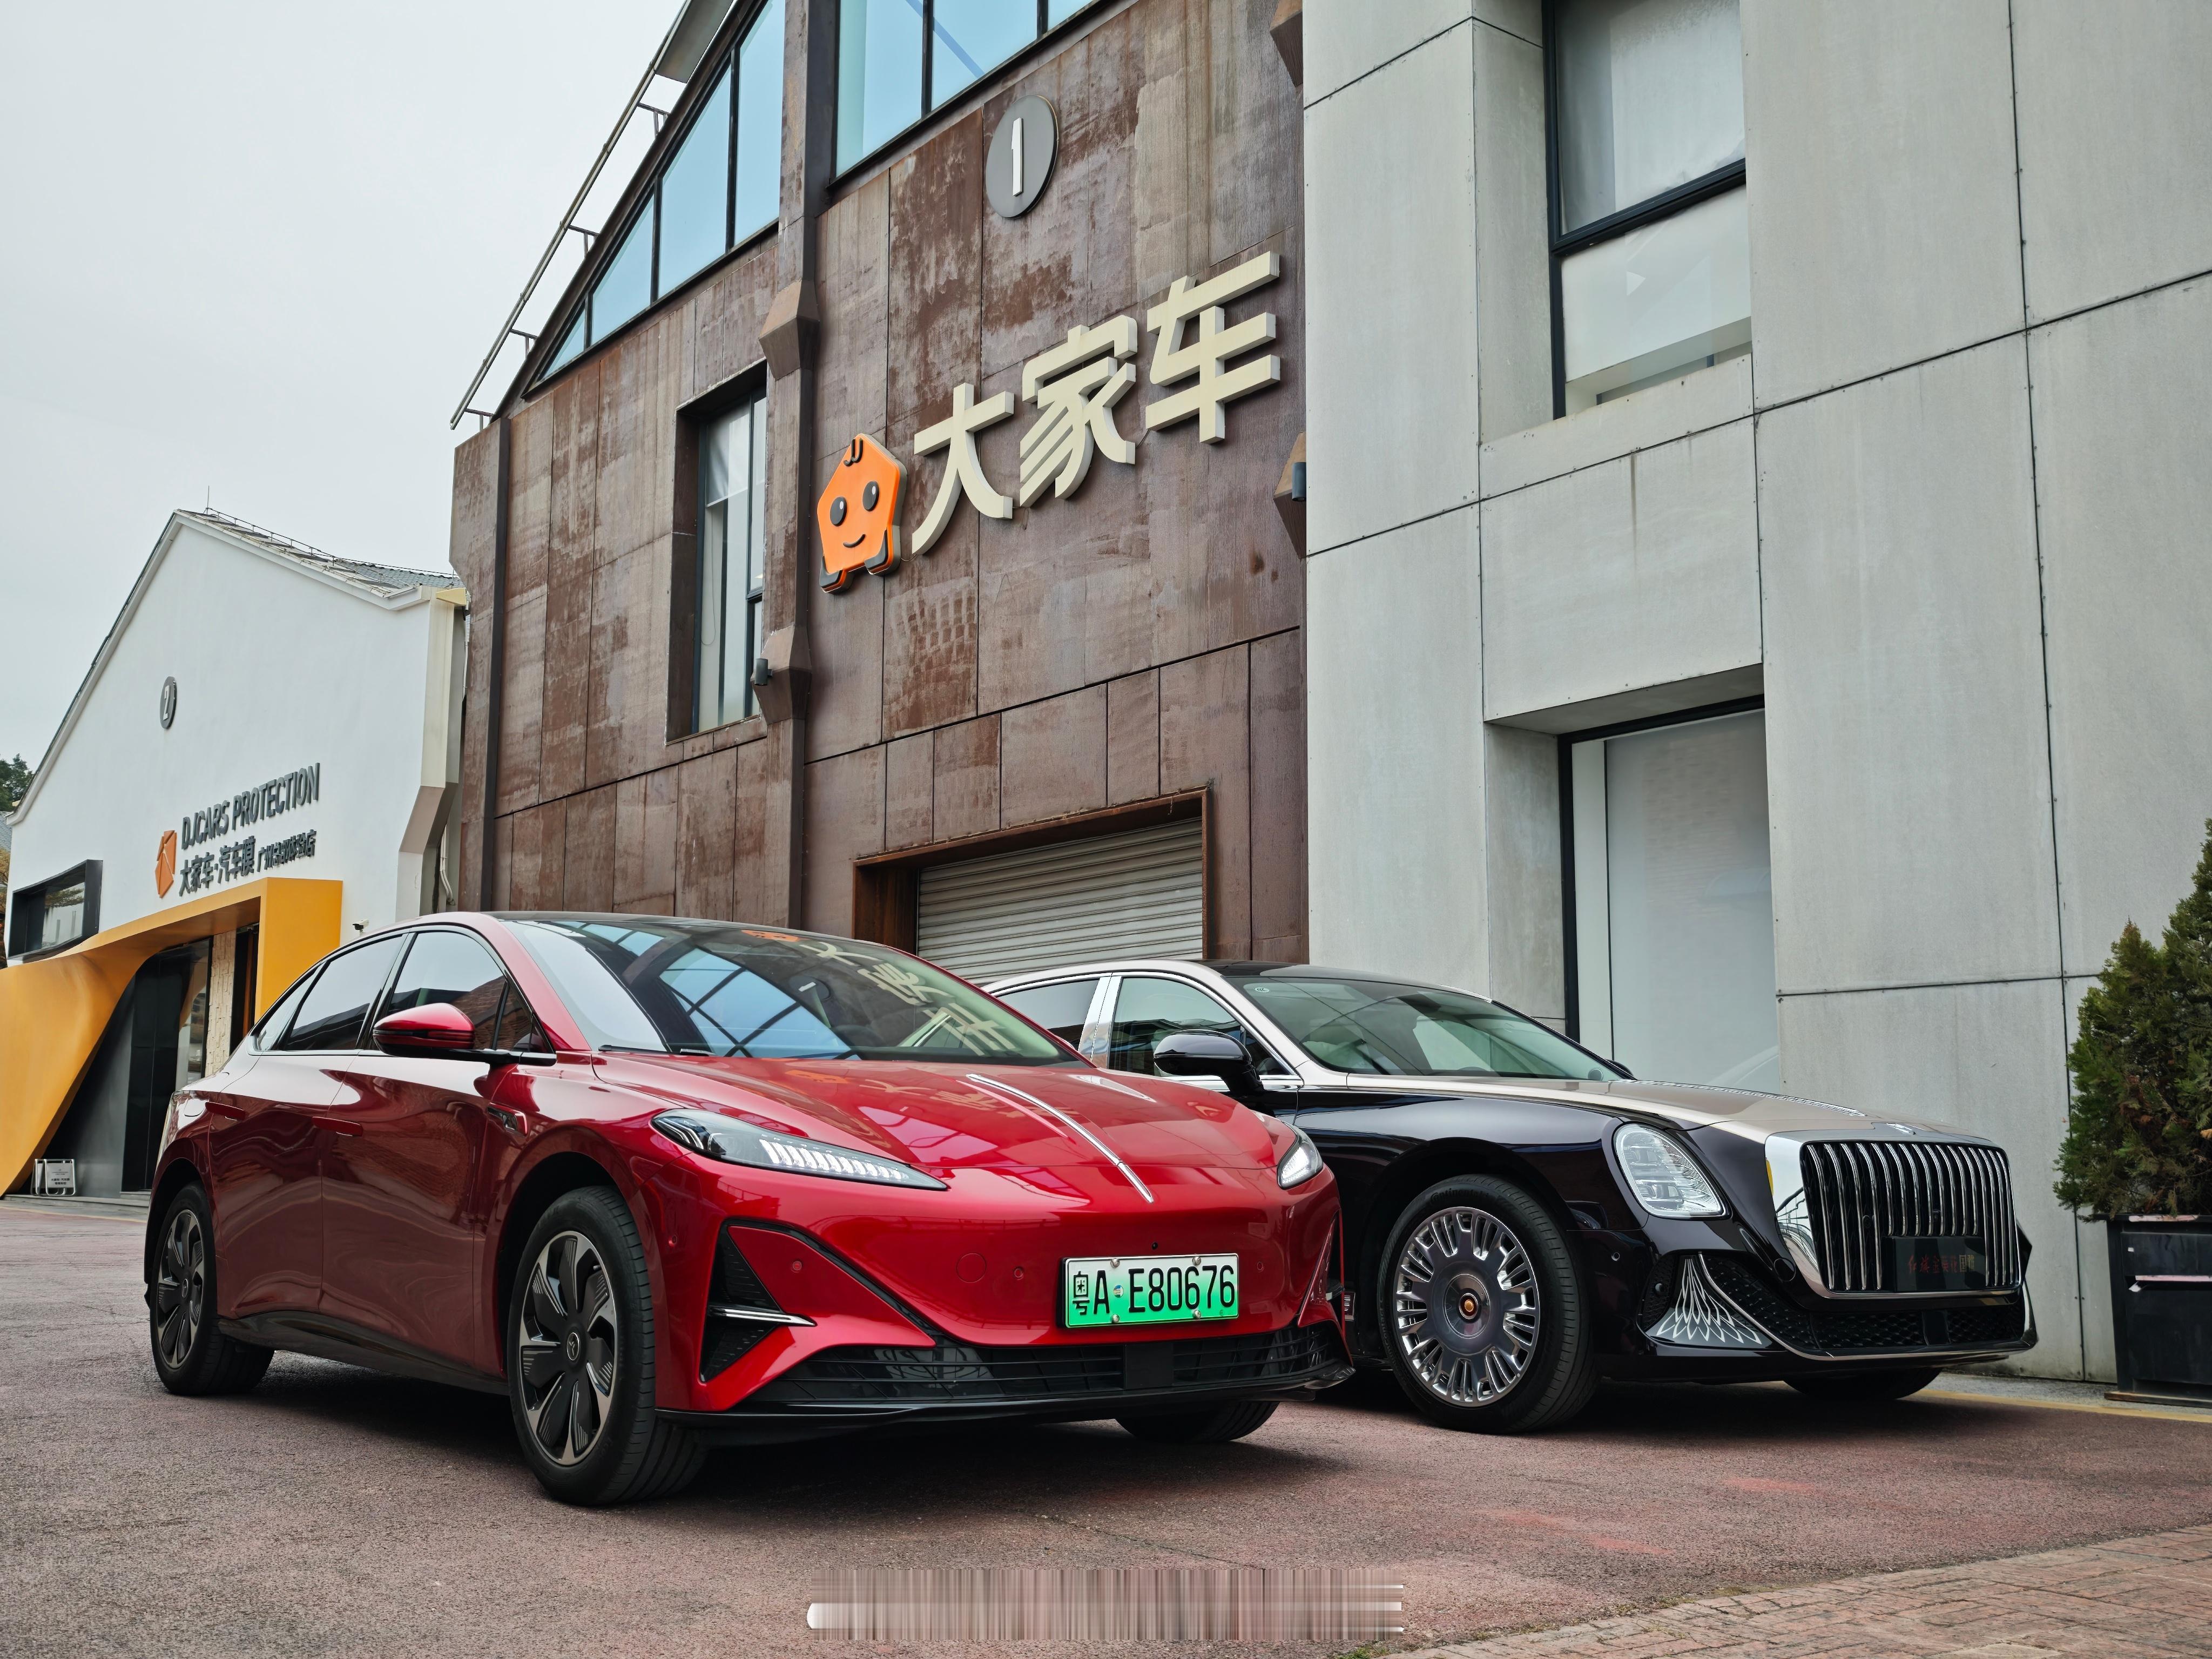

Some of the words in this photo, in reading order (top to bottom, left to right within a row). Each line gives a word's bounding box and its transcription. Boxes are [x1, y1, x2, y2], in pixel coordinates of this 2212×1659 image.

[1011, 117, 1023, 196] 1
[912, 251, 1280, 555] 大家车
[163, 685, 171, 720] 2
[181, 800, 230, 850] DJCARS
[231, 763, 320, 831] PROTECTION
